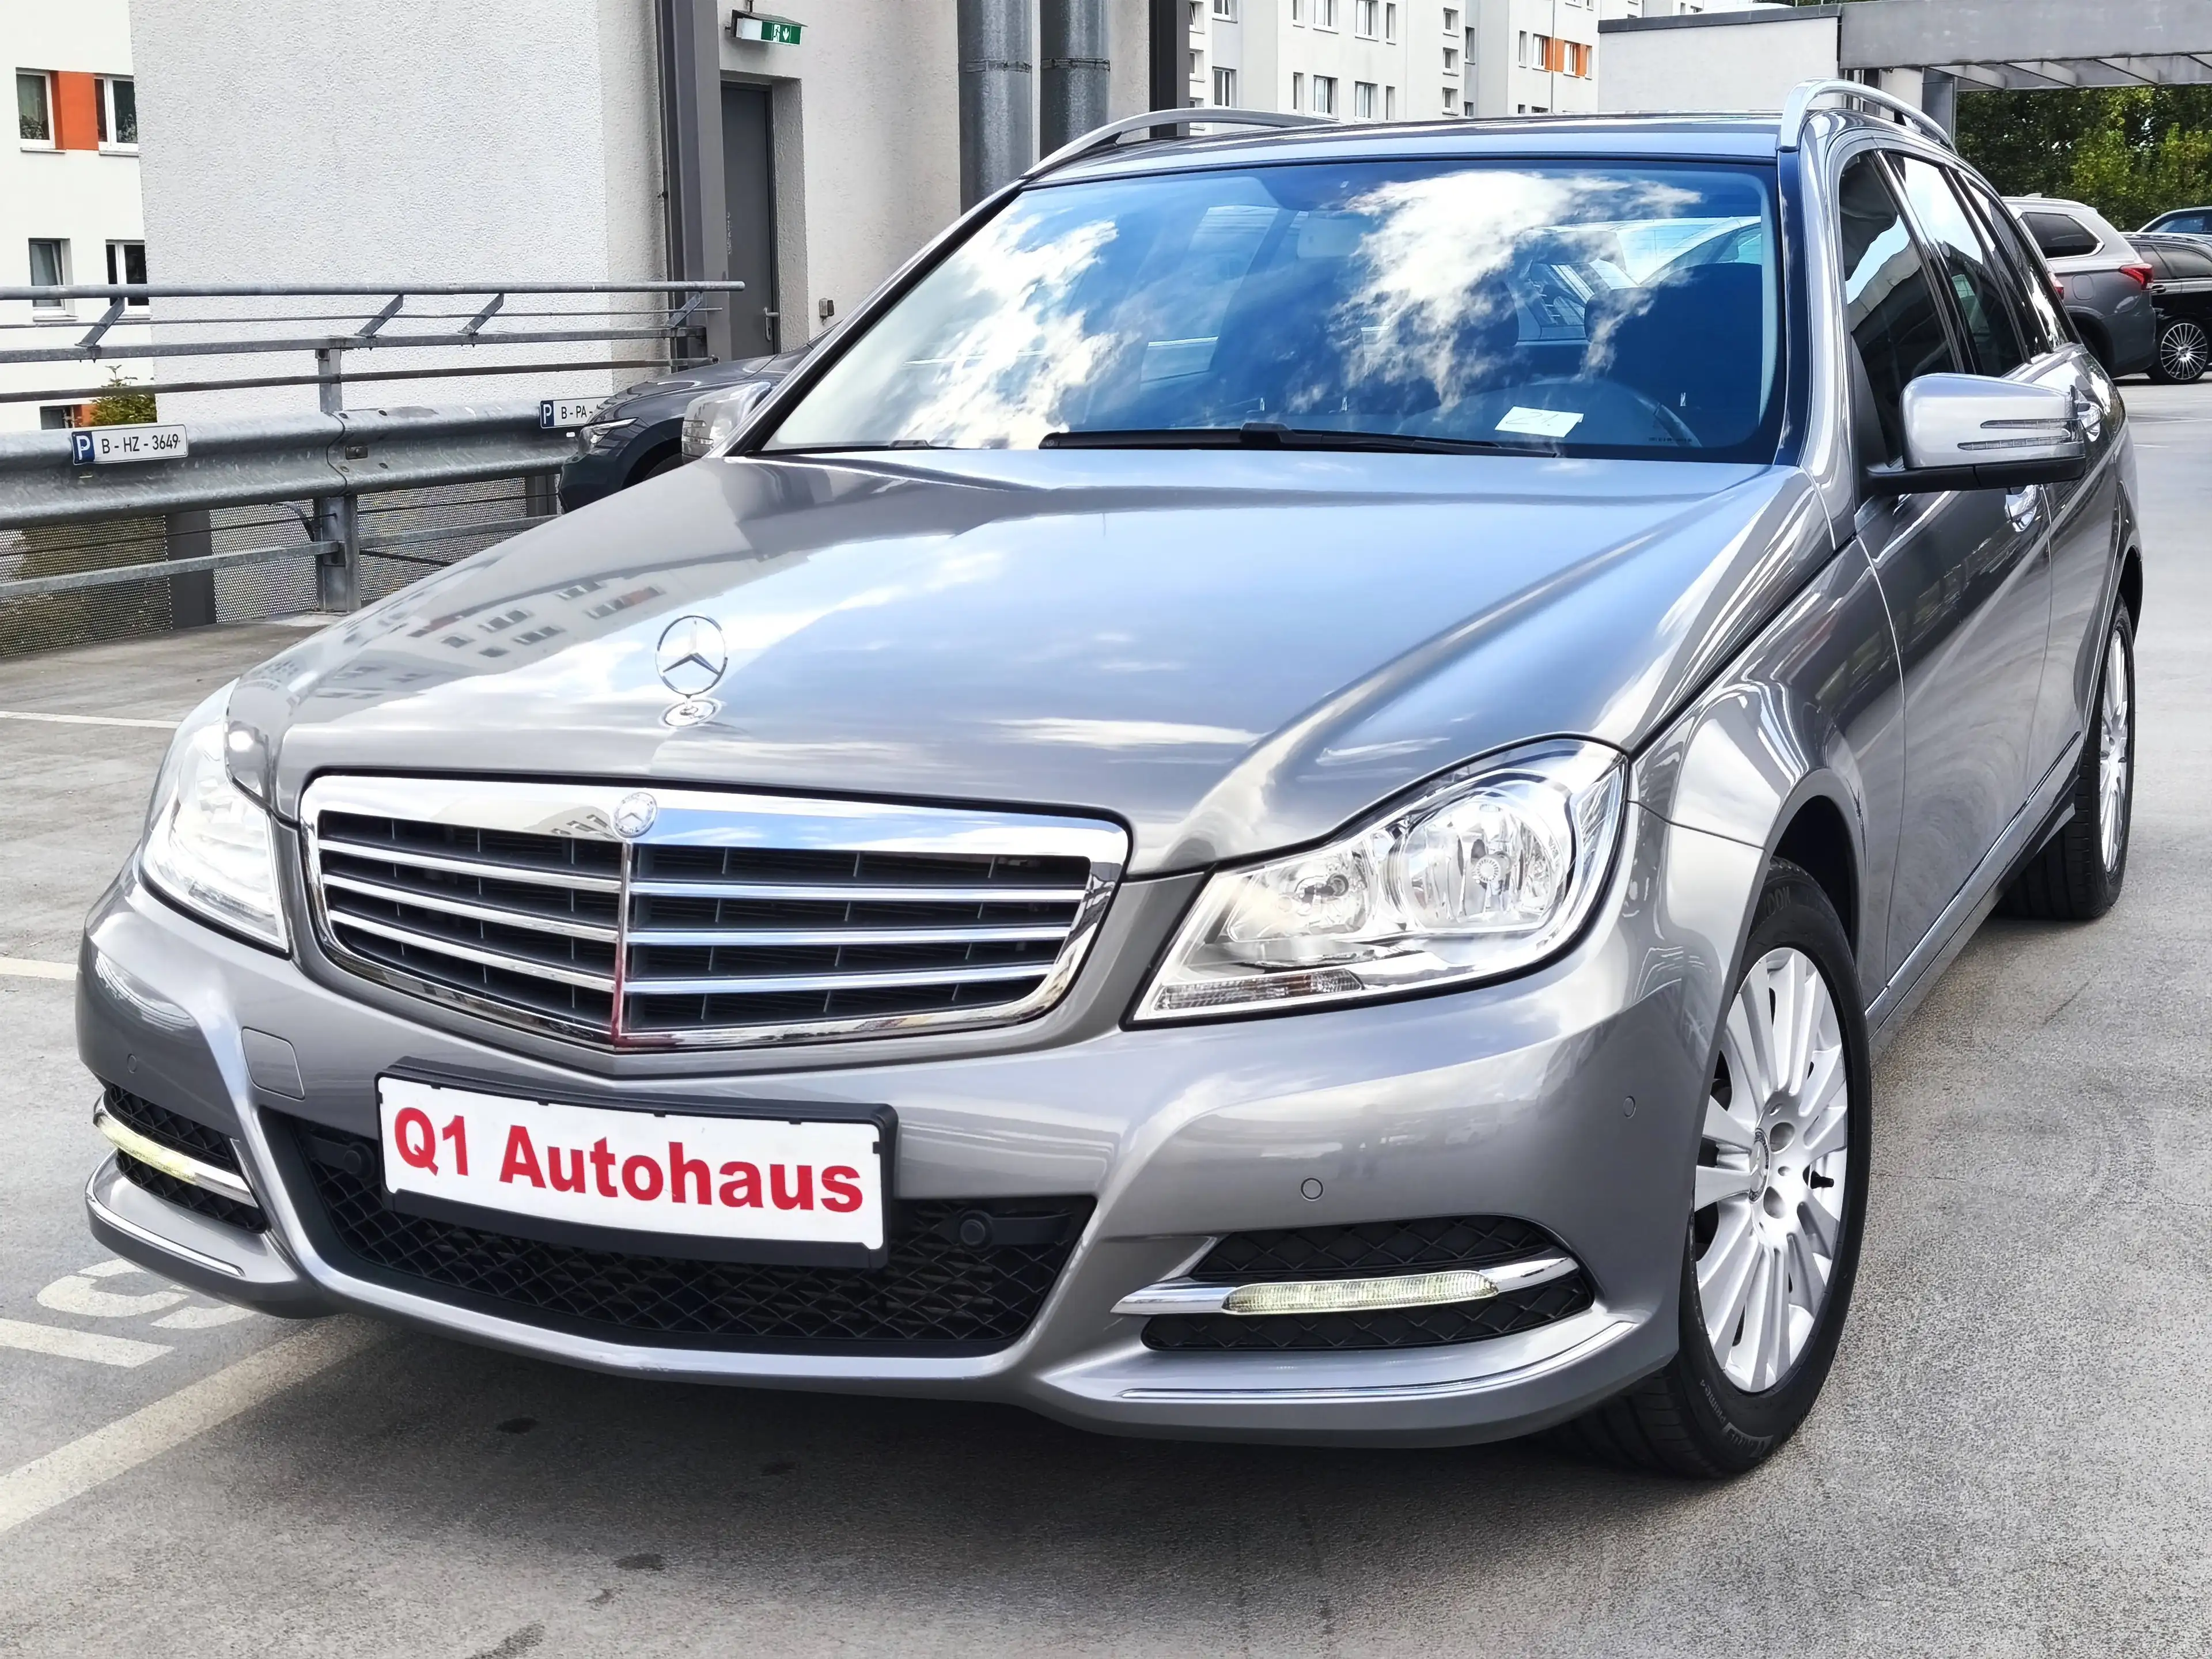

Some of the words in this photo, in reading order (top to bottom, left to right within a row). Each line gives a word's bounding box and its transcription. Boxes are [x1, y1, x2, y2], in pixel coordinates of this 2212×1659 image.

[543, 404, 552, 424] P
[76, 435, 90, 460] P
[152, 433, 179, 450] 3649
[395, 1107, 468, 1176] Q1
[499, 1124, 863, 1213] Autohaus
